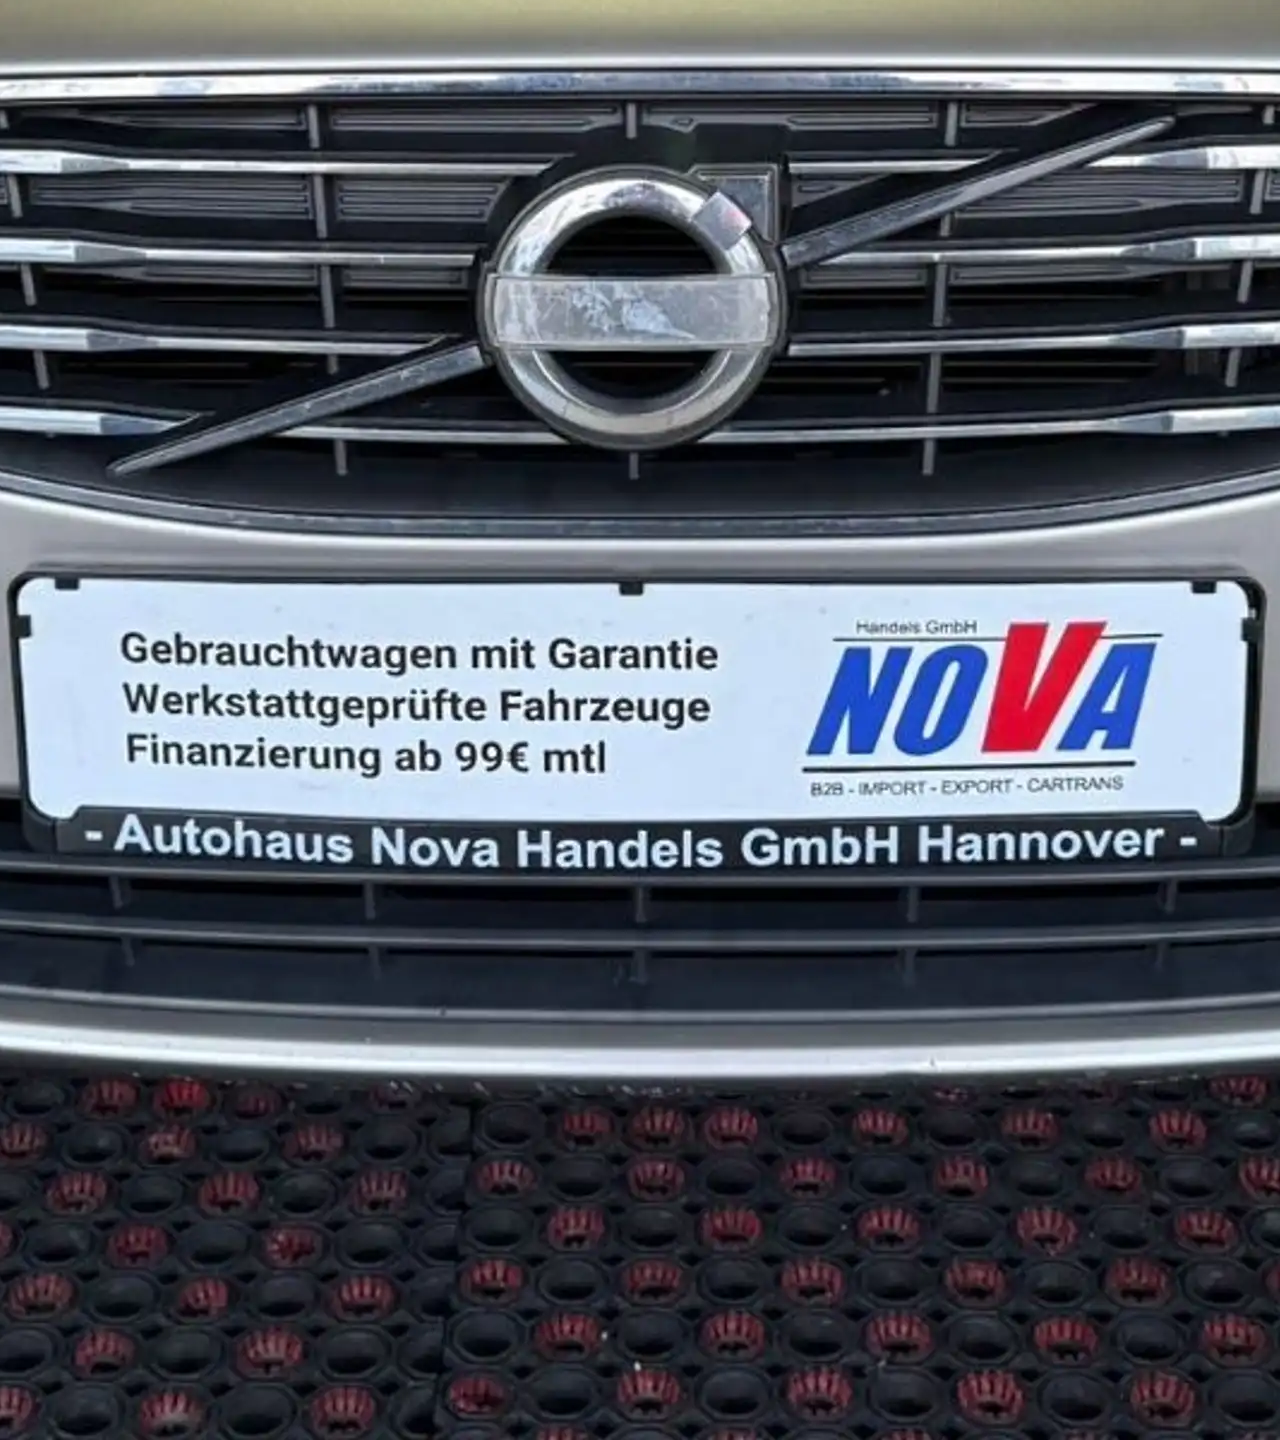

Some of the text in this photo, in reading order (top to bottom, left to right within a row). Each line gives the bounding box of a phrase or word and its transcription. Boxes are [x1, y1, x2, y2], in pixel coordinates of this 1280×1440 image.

[856, 619, 978, 635] Handels GmbH
[120, 631, 719, 676] Gebrauchtwagen mit Garantie
[122, 681, 711, 731] Werkstattgeprüfte Fahrzeuge
[805, 620, 1157, 757] NOVA
[126, 732, 606, 779] Finanzierung ab 99€ mtl
[810, 783, 844, 797] B2B
[858, 781, 927, 796] IMPORT
[941, 779, 1014, 794] EXPORT
[1027, 776, 1124, 793] CARTRANS
[114, 813, 354, 863] Autohaus
[371, 826, 500, 868] Nova
[517, 829, 724, 869] Handels
[741, 825, 899, 867] GmbH
[920, 824, 1165, 864] Hannover
